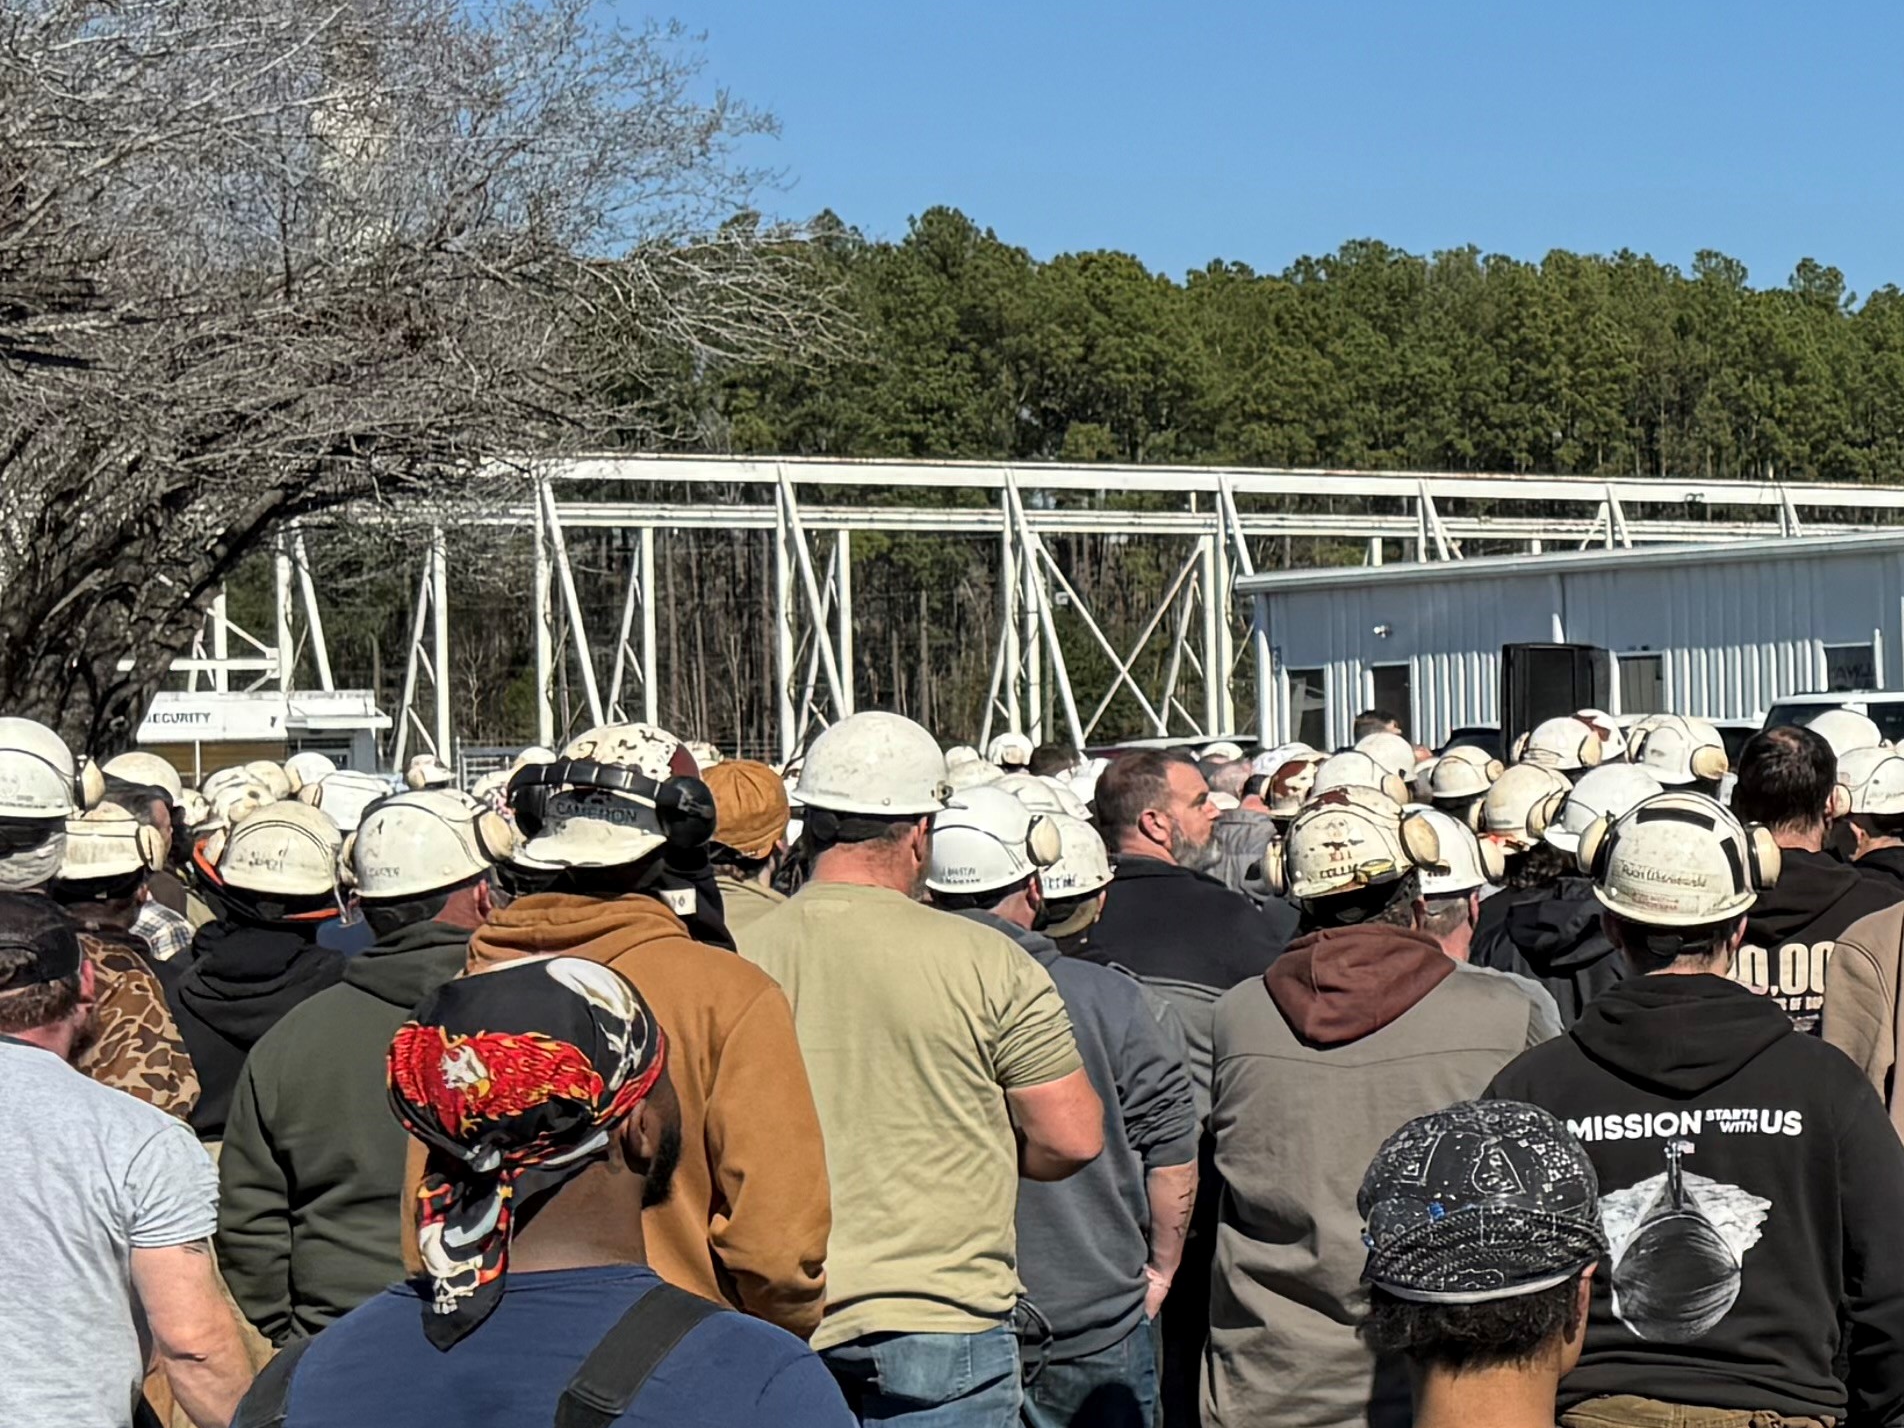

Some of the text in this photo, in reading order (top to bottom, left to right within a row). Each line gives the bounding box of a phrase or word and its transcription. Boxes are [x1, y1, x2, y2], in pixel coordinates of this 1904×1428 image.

[1567, 1109, 1802, 1141] MISSION STARTS WITH US
